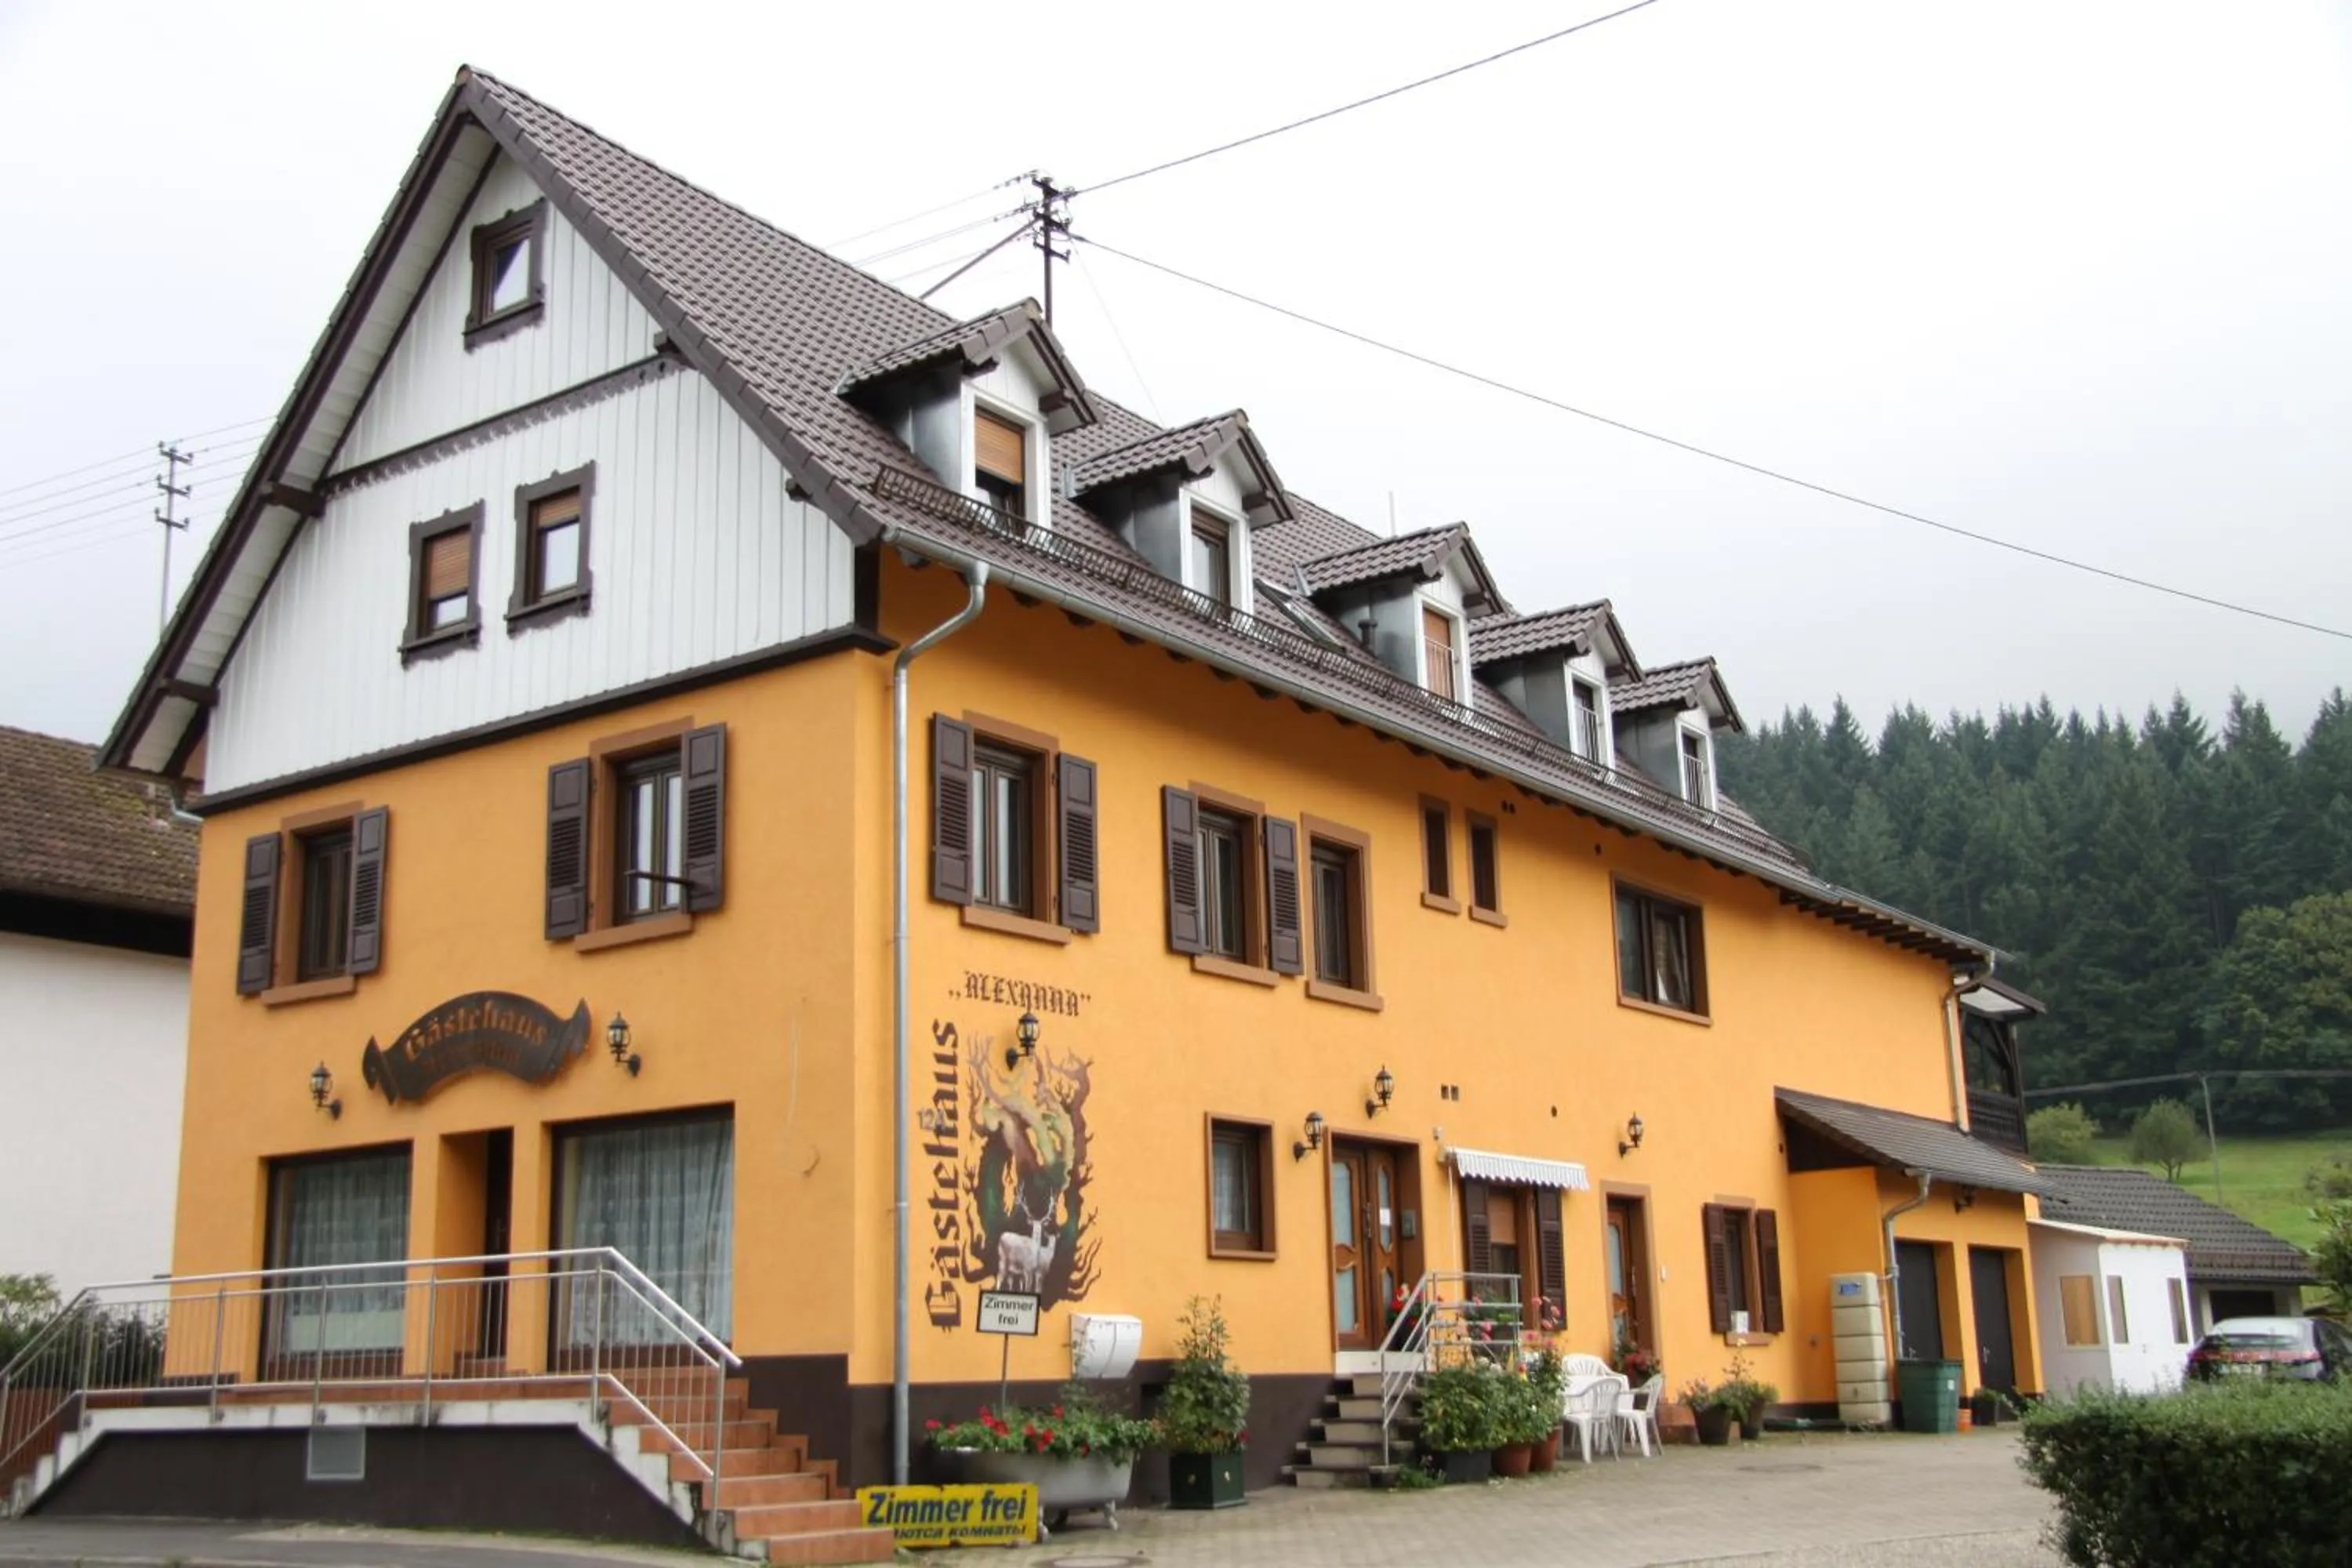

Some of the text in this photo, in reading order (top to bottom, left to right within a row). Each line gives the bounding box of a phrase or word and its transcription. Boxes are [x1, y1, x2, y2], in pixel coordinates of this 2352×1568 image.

[923, 1018, 961, 1334] Gästehaus
[984, 1296, 1034, 1312] Zimmer
[998, 1313, 1018, 1325] frei
[868, 1489, 1027, 1524] Zimmer frei
